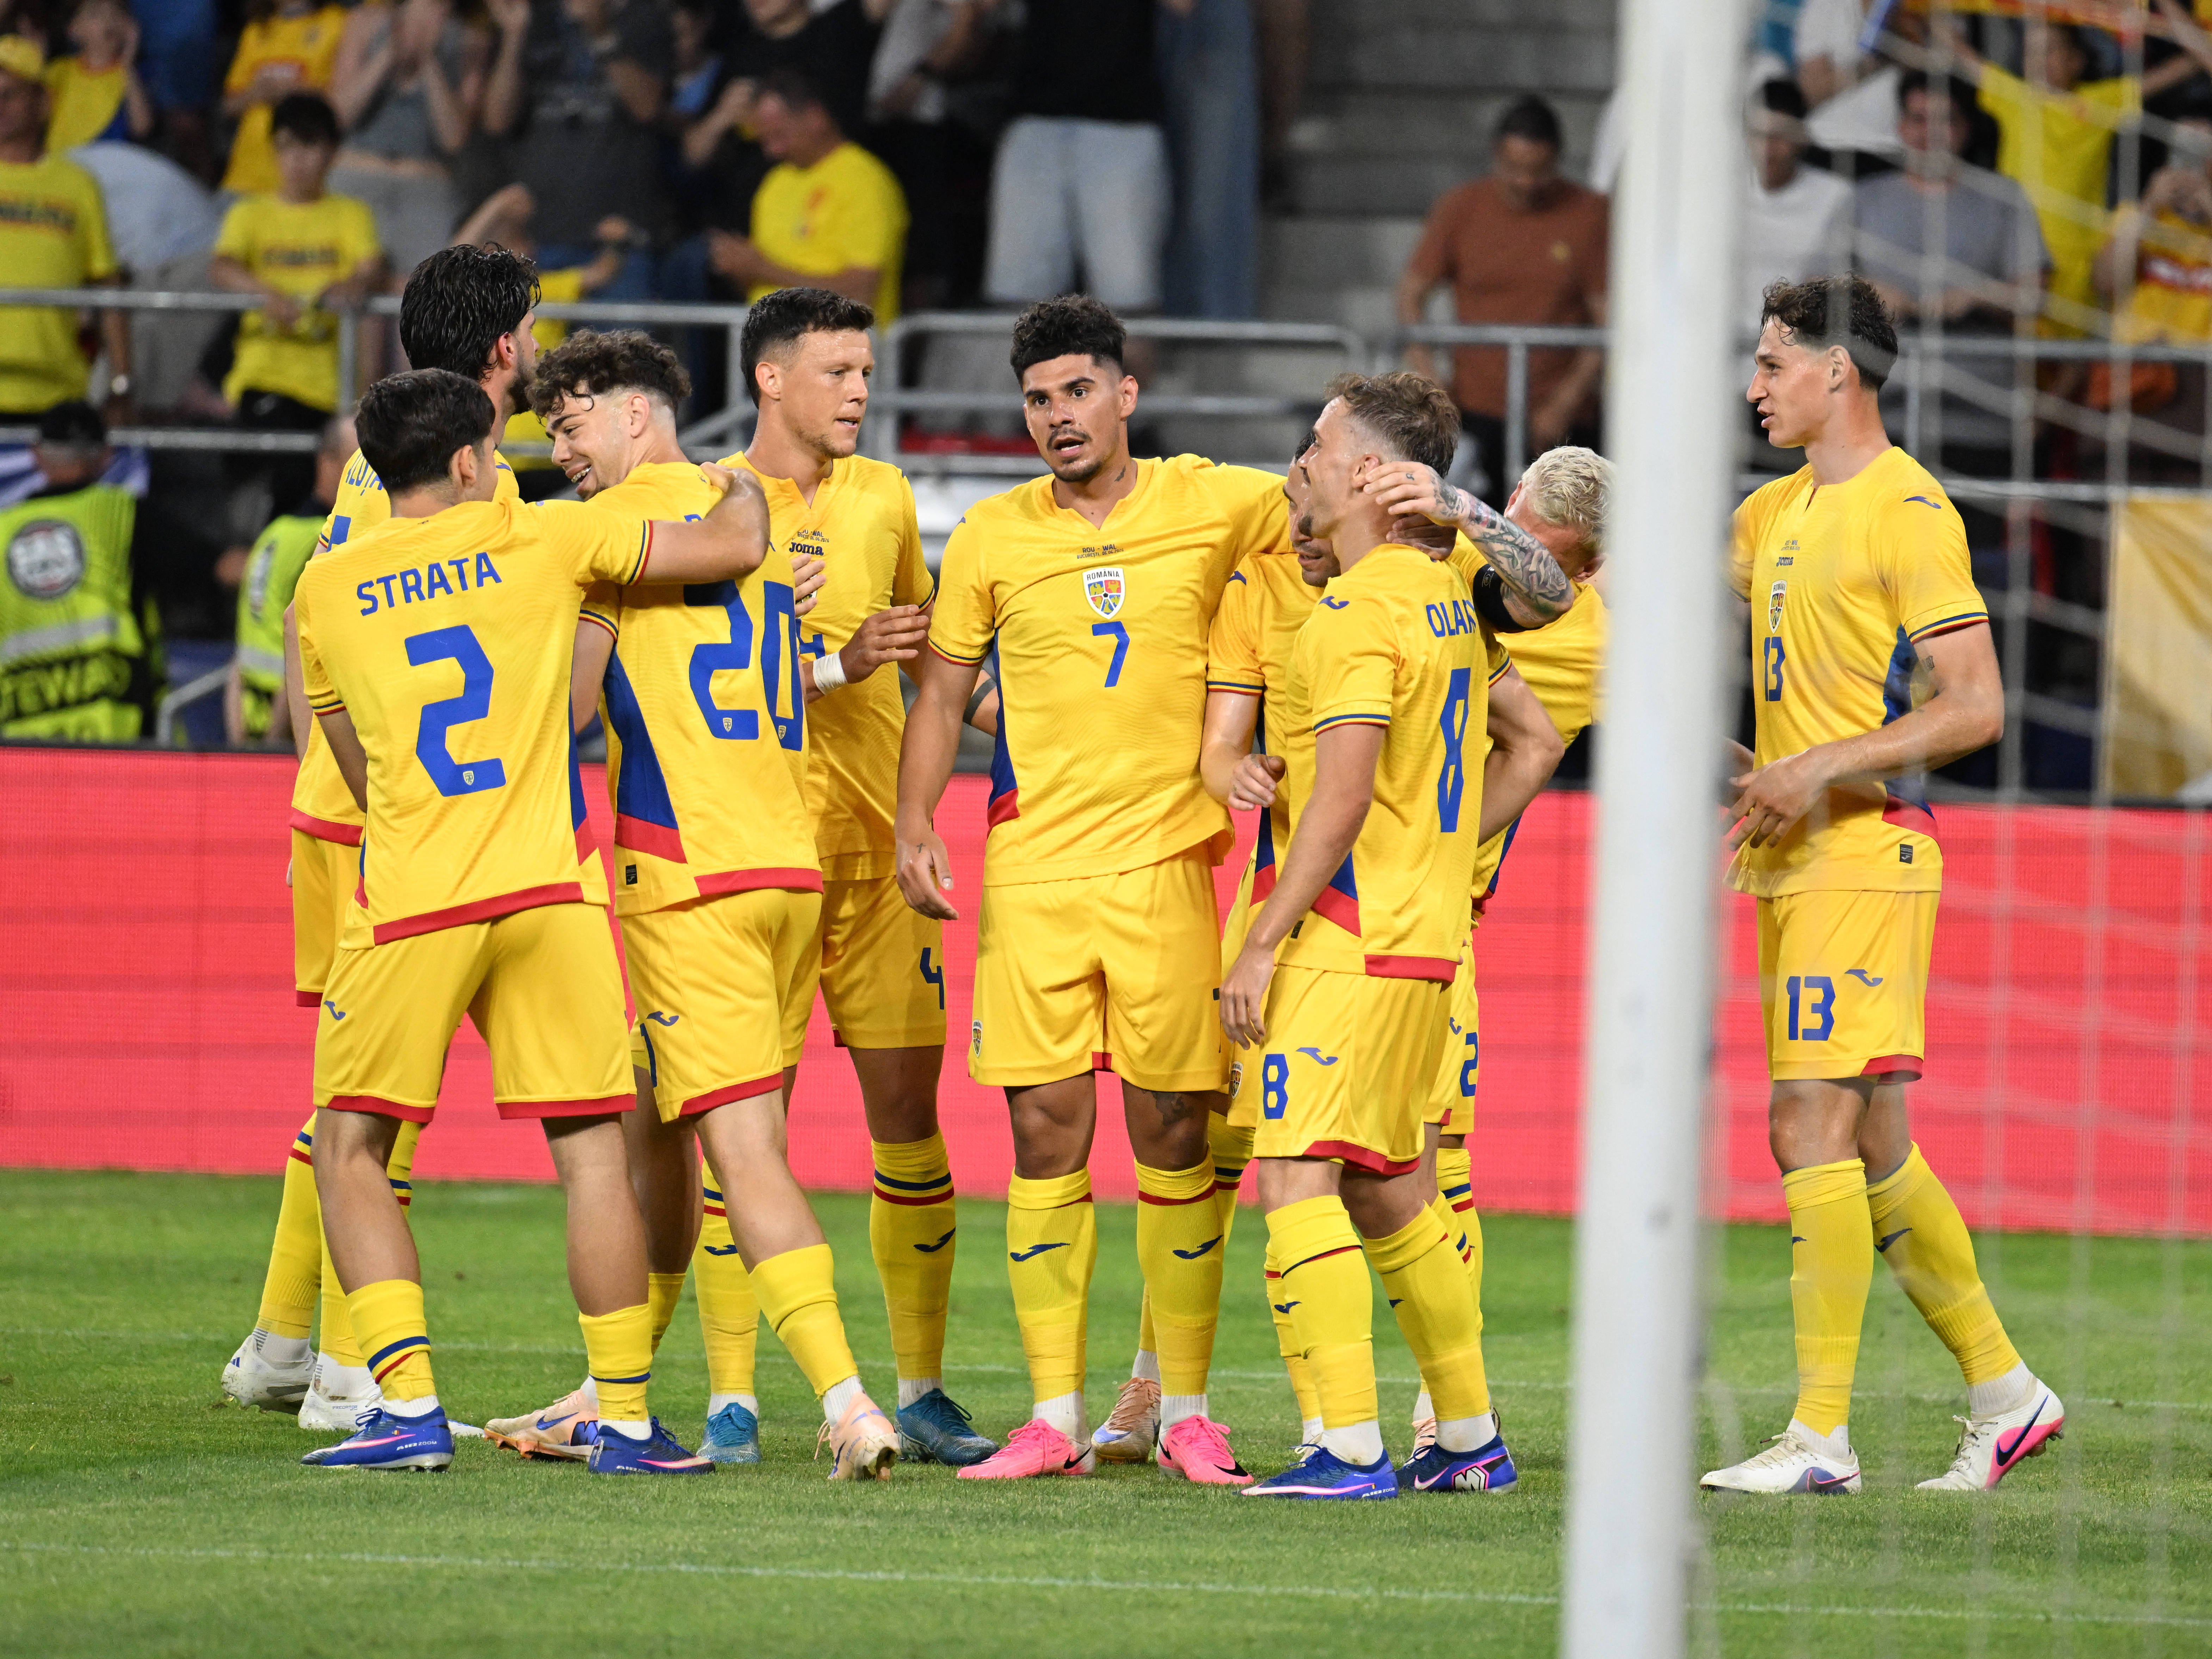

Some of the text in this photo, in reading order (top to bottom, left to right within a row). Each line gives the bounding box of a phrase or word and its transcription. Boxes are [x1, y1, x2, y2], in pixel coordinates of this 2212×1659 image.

[357, 552, 502, 616] STRATA
[1087, 569, 1120, 581] ROMÂNIA
[684, 580, 803, 751] 20
[1092, 621, 1130, 687] 7
[1763, 637, 1785, 701] 13
[404, 624, 507, 797] 2
[1437, 667, 1471, 833] 8
[920, 947, 944, 1010] 4
[1786, 976, 1836, 1041] 13
[1262, 1053, 1290, 1120] 8
[396, 1443, 417, 1451] AIR
